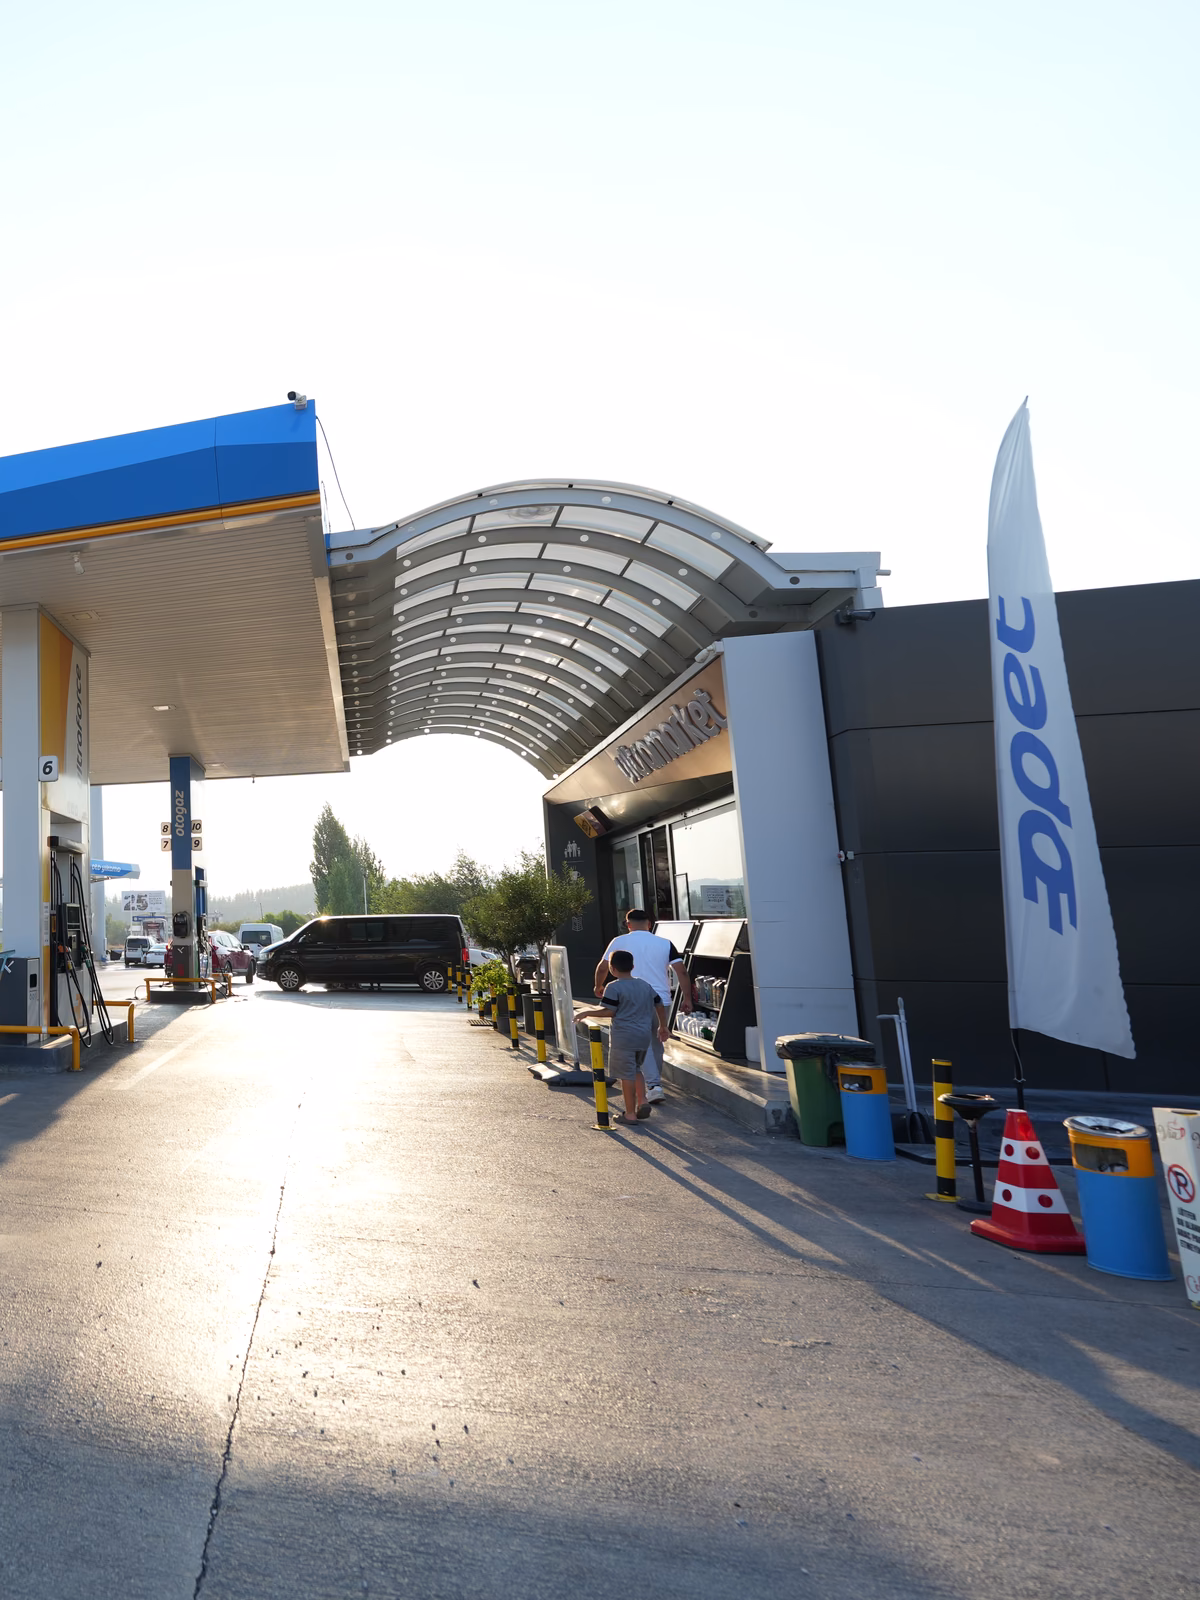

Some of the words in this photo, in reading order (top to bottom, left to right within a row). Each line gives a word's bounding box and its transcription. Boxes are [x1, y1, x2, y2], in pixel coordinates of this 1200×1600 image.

[42, 760, 53, 775] 6
[995, 595, 1078, 936] opet
[175, 790, 188, 837] otogaz
[162, 824, 169, 833] 8
[191, 822, 202, 831] 10
[163, 840, 169, 849] 7
[193, 839, 200, 848] 9
